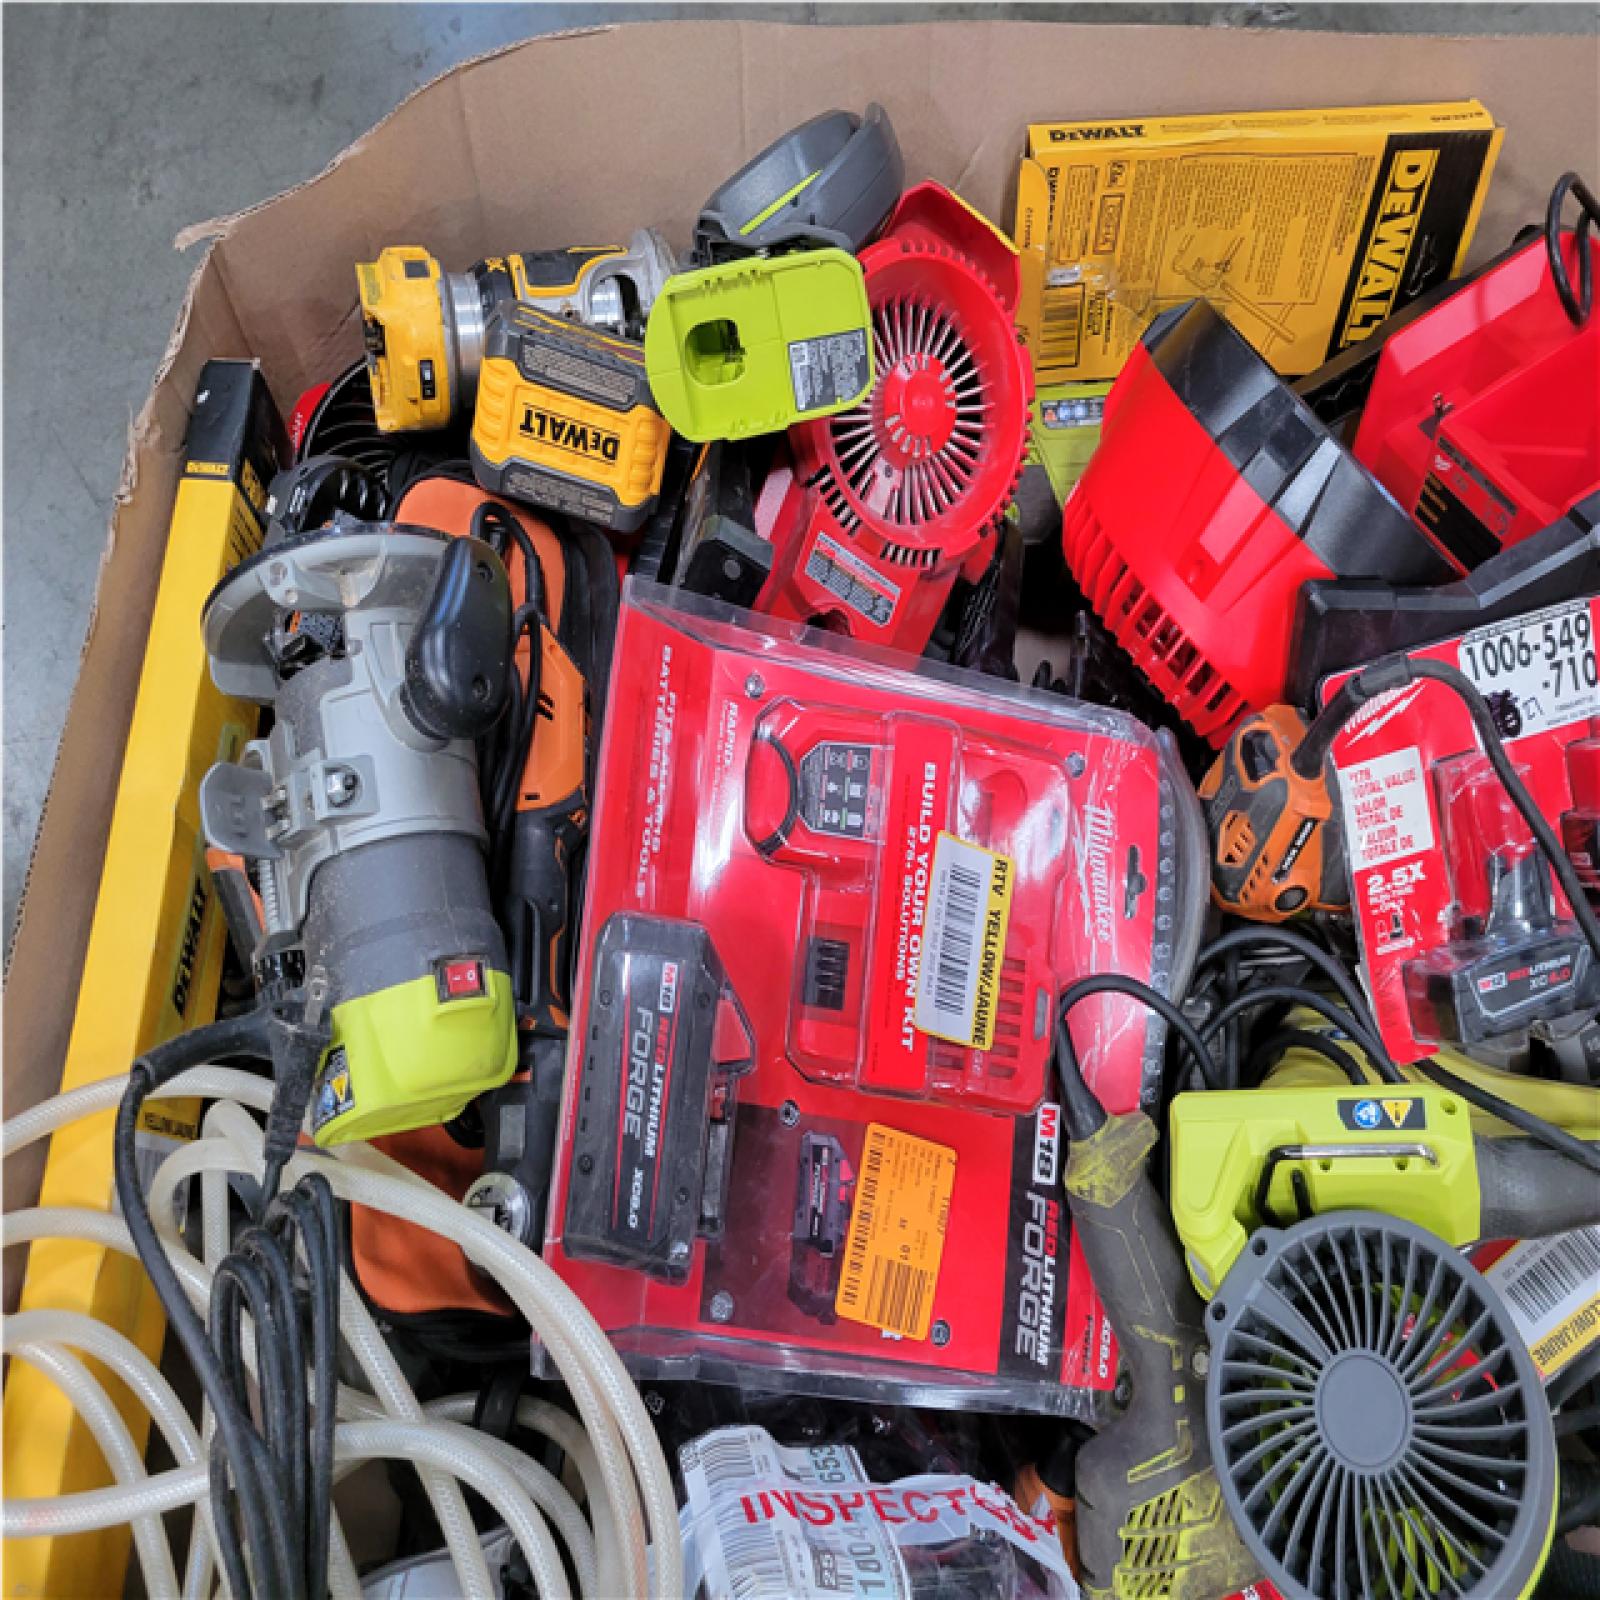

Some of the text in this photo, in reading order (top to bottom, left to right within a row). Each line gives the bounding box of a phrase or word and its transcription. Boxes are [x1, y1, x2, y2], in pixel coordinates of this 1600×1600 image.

[1048, 124, 1145, 142] DEWALT
[1344, 150, 1434, 343] DEWALT
[519, 408, 621, 461] DEWALT
[649, 645, 672, 780] BATTERIES
[1465, 611, 1592, 683] 1006-549
[724, 701, 739, 767] RAPID
[635, 815, 654, 898] TOOLS
[902, 762, 937, 1051] BUILD YOUR OWN KIT
[1084, 802, 1114, 942] Milwaukee
[1367, 860, 1427, 897] 2.5X
[895, 874, 914, 981] SOLUTIONS
[972, 858, 1008, 1045] RTV YELLOW/JAUNE
[624, 1006, 654, 1140] FORGE
[644, 962, 677, 1157] M18 REDLITHIUM
[1014, 1190, 1047, 1362] FORGE
[1036, 1104, 1061, 1367] M18 REDLITHIUM
